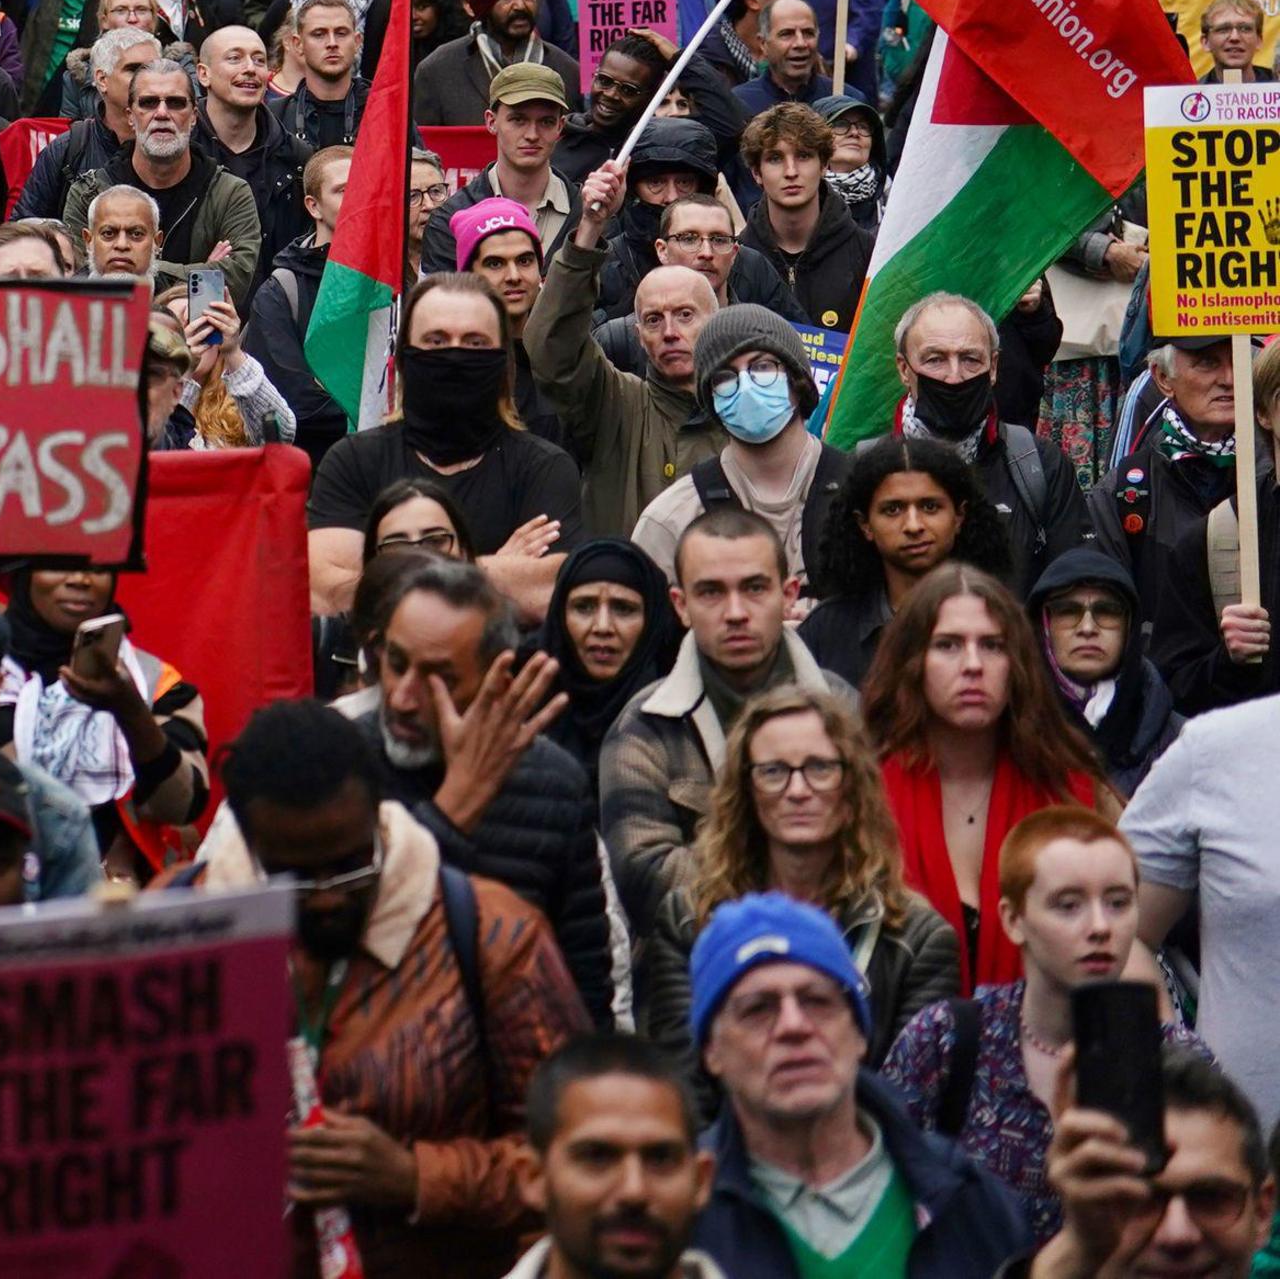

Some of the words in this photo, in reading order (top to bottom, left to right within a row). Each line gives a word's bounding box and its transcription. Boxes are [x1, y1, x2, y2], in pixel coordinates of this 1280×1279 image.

[589, 2, 628, 26] THE
[631, 0, 667, 23] FAR
[1171, 129, 1280, 168] STOP
[1172, 170, 1254, 208] THE
[1174, 211, 1251, 248] FAR
[1176, 250, 1280, 289] RIGH
[132, 1040, 255, 1130] FAR
